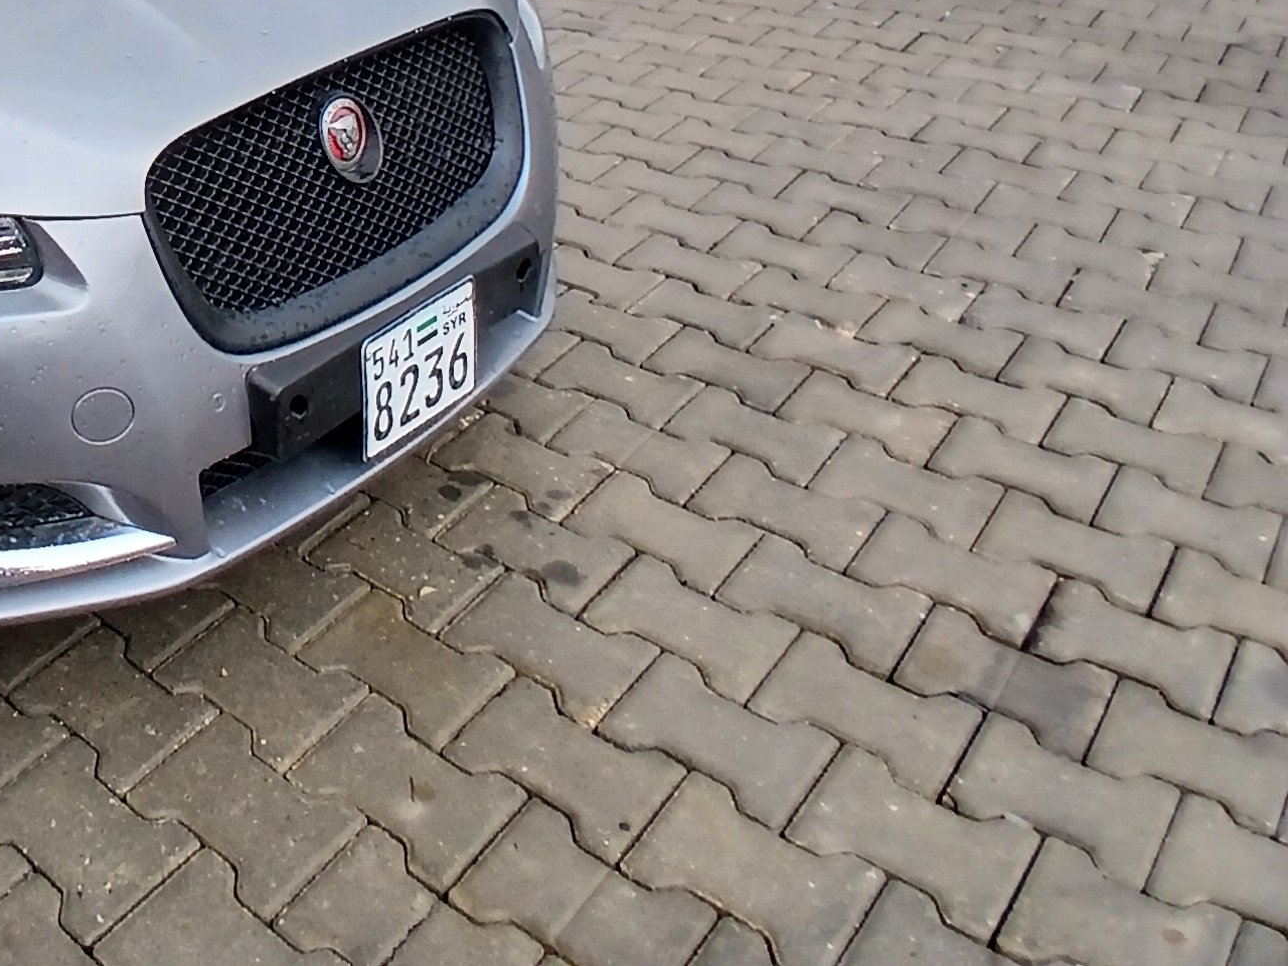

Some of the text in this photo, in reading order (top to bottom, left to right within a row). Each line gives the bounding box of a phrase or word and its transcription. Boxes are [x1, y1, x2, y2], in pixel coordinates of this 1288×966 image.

[443, 312, 466, 335] SYR
[373, 329, 414, 380] 541
[374, 332, 468, 441] 8236
